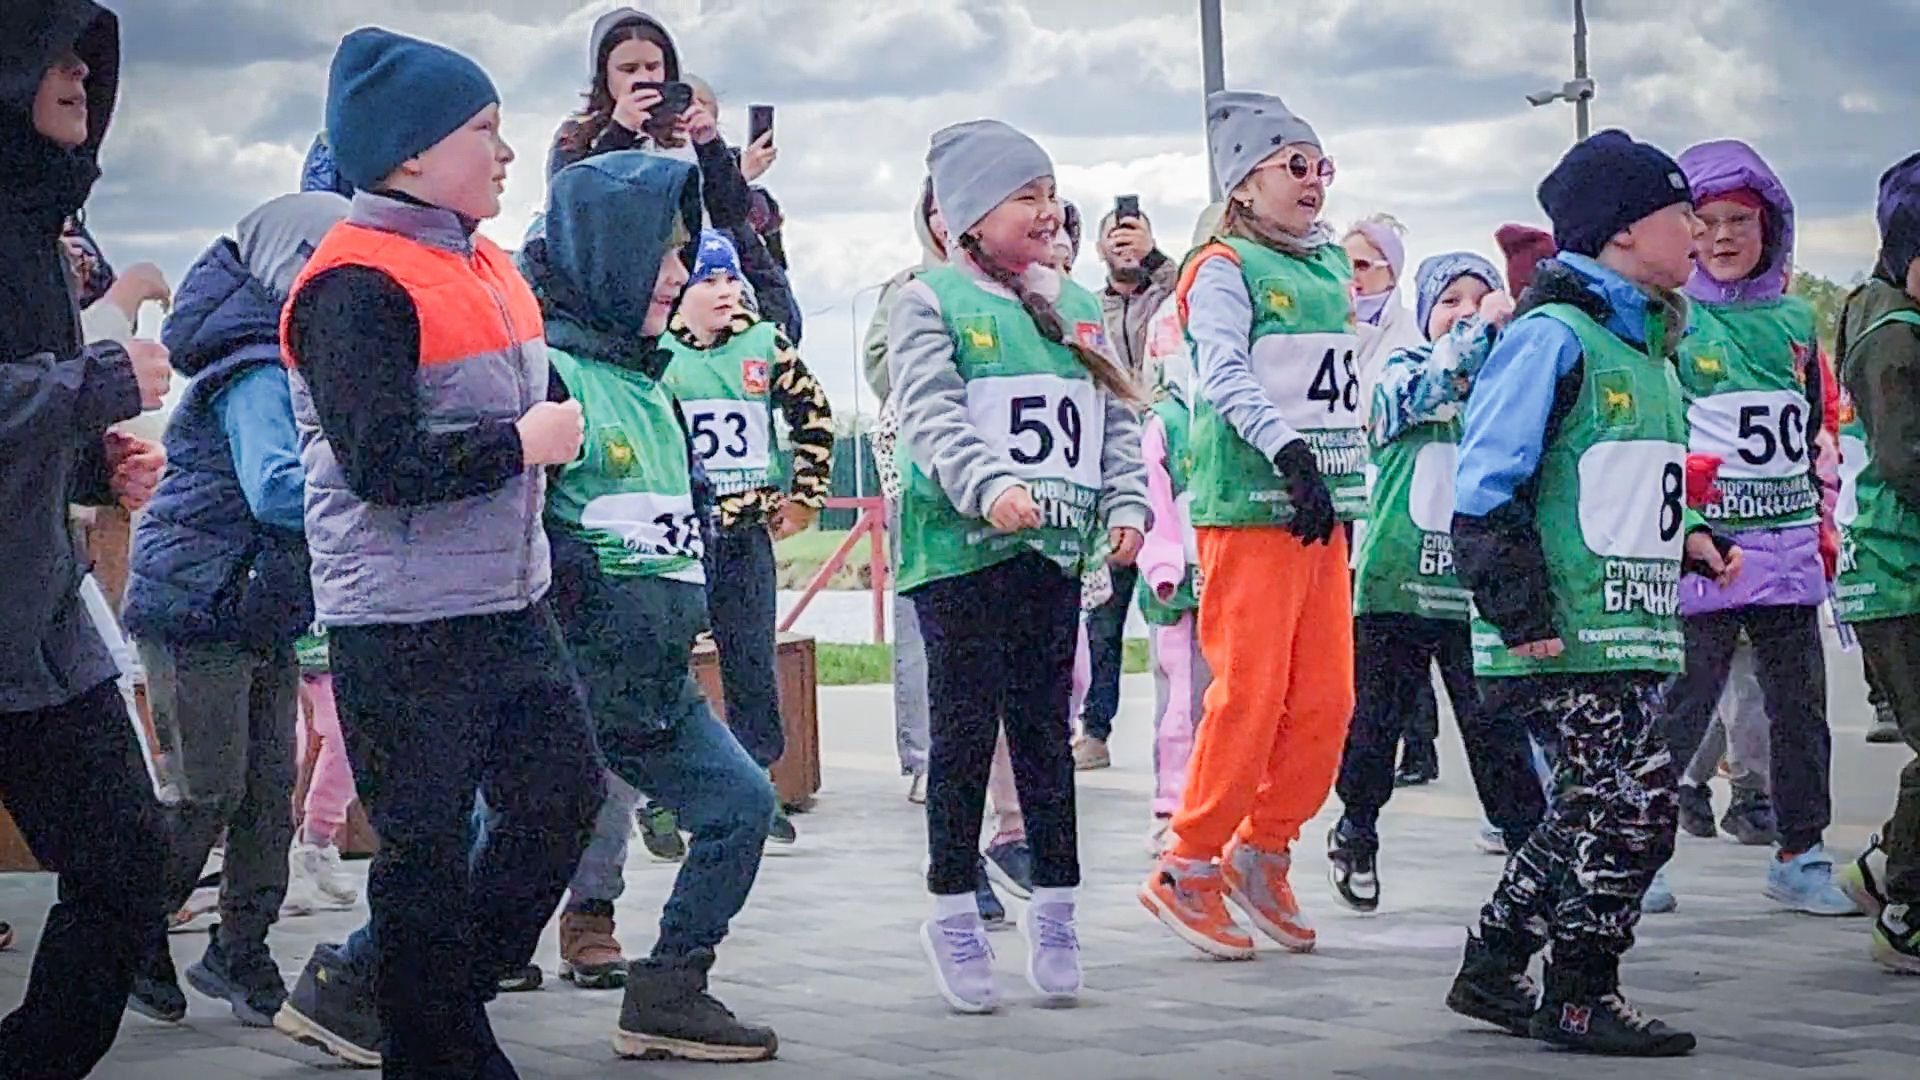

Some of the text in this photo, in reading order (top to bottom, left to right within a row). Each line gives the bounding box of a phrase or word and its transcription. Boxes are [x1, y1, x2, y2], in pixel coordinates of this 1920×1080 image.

[1306, 348, 1360, 413] 48
[688, 411, 748, 460] 53
[1009, 394, 1082, 469] 59
[1737, 403, 1804, 466] 50
[1659, 461, 1683, 542] 8
[1420, 548, 1457, 576] БР
[1422, 533, 1455, 550] СПО
